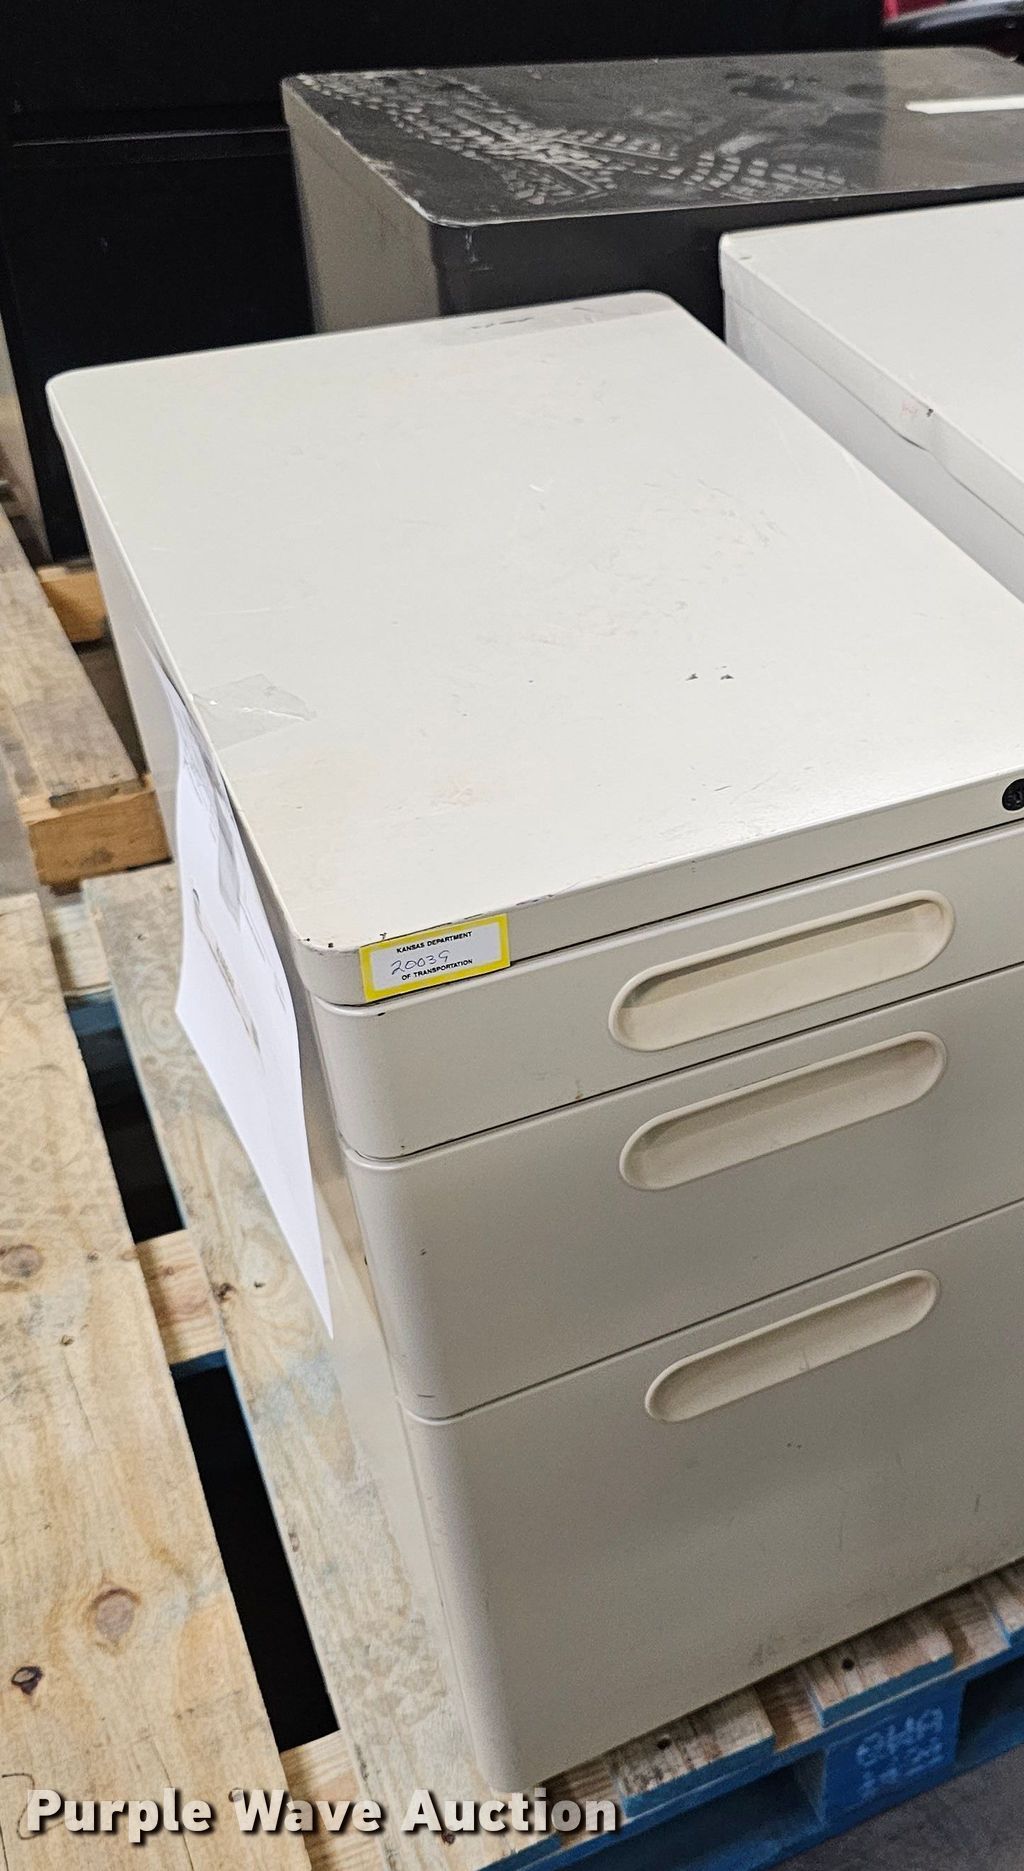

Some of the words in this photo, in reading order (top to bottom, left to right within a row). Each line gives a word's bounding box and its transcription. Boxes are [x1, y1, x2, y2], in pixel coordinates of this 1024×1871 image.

[396, 942, 425, 954] KANSAS
[427, 931, 473, 947] DEPARTMENT
[401, 973, 412, 981] OF
[413, 959, 474, 978] TRANSPORTATION
